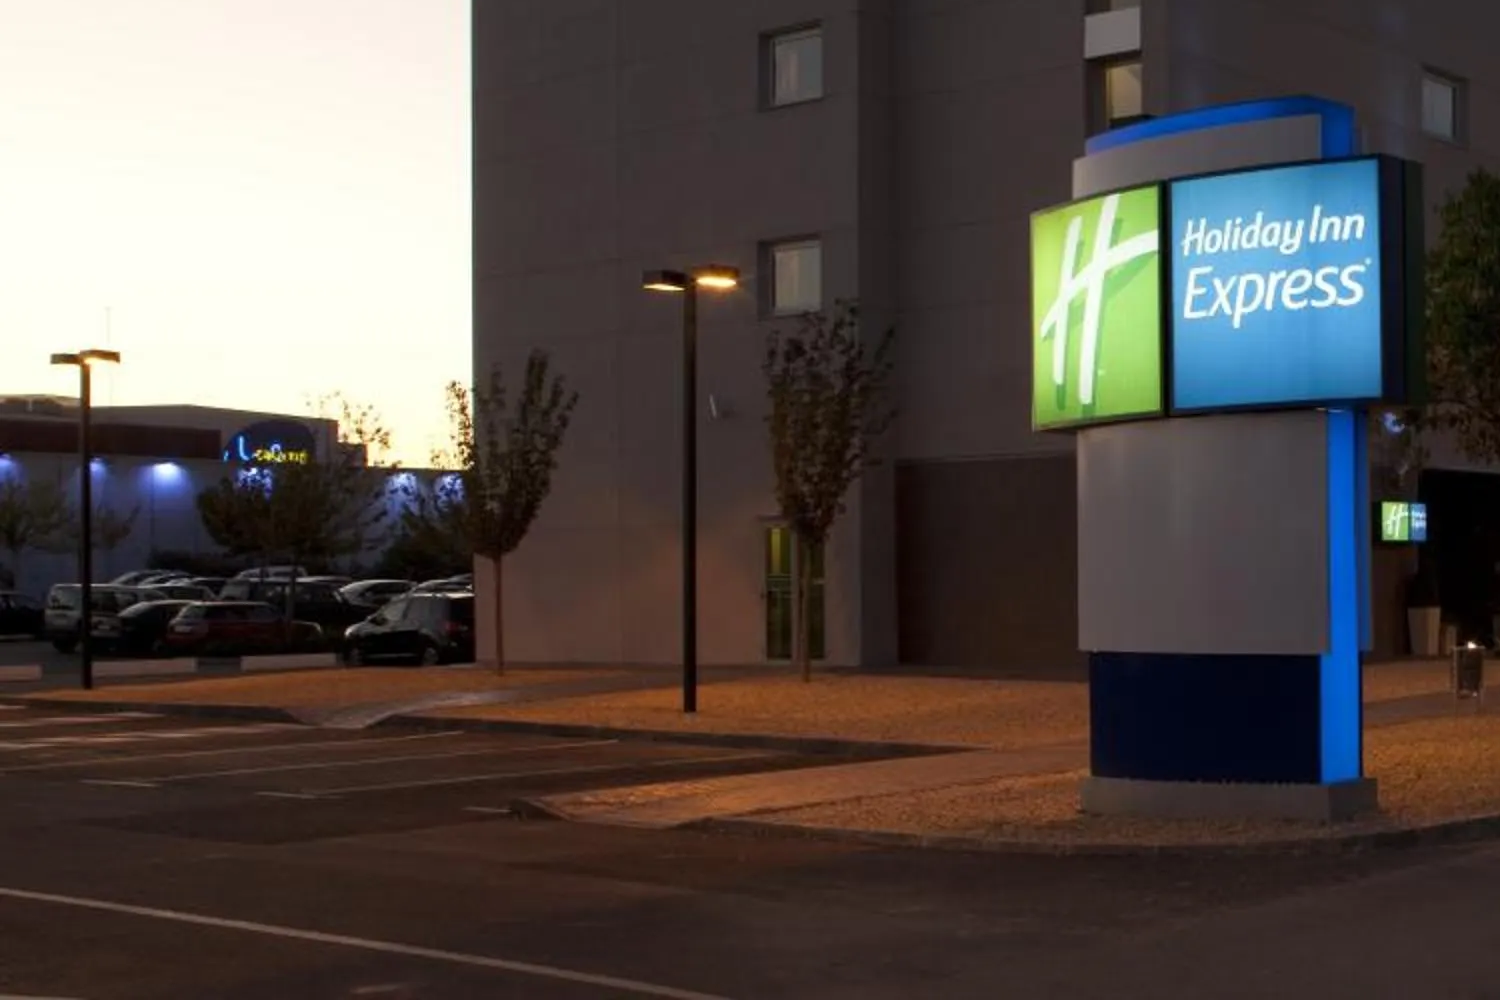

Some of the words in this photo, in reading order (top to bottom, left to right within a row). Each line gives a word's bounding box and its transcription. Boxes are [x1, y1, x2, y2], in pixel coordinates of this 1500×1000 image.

[1181, 211, 1302, 255] Holiday
[1309, 205, 1365, 242] Inn
[1182, 264, 1365, 328] Express
